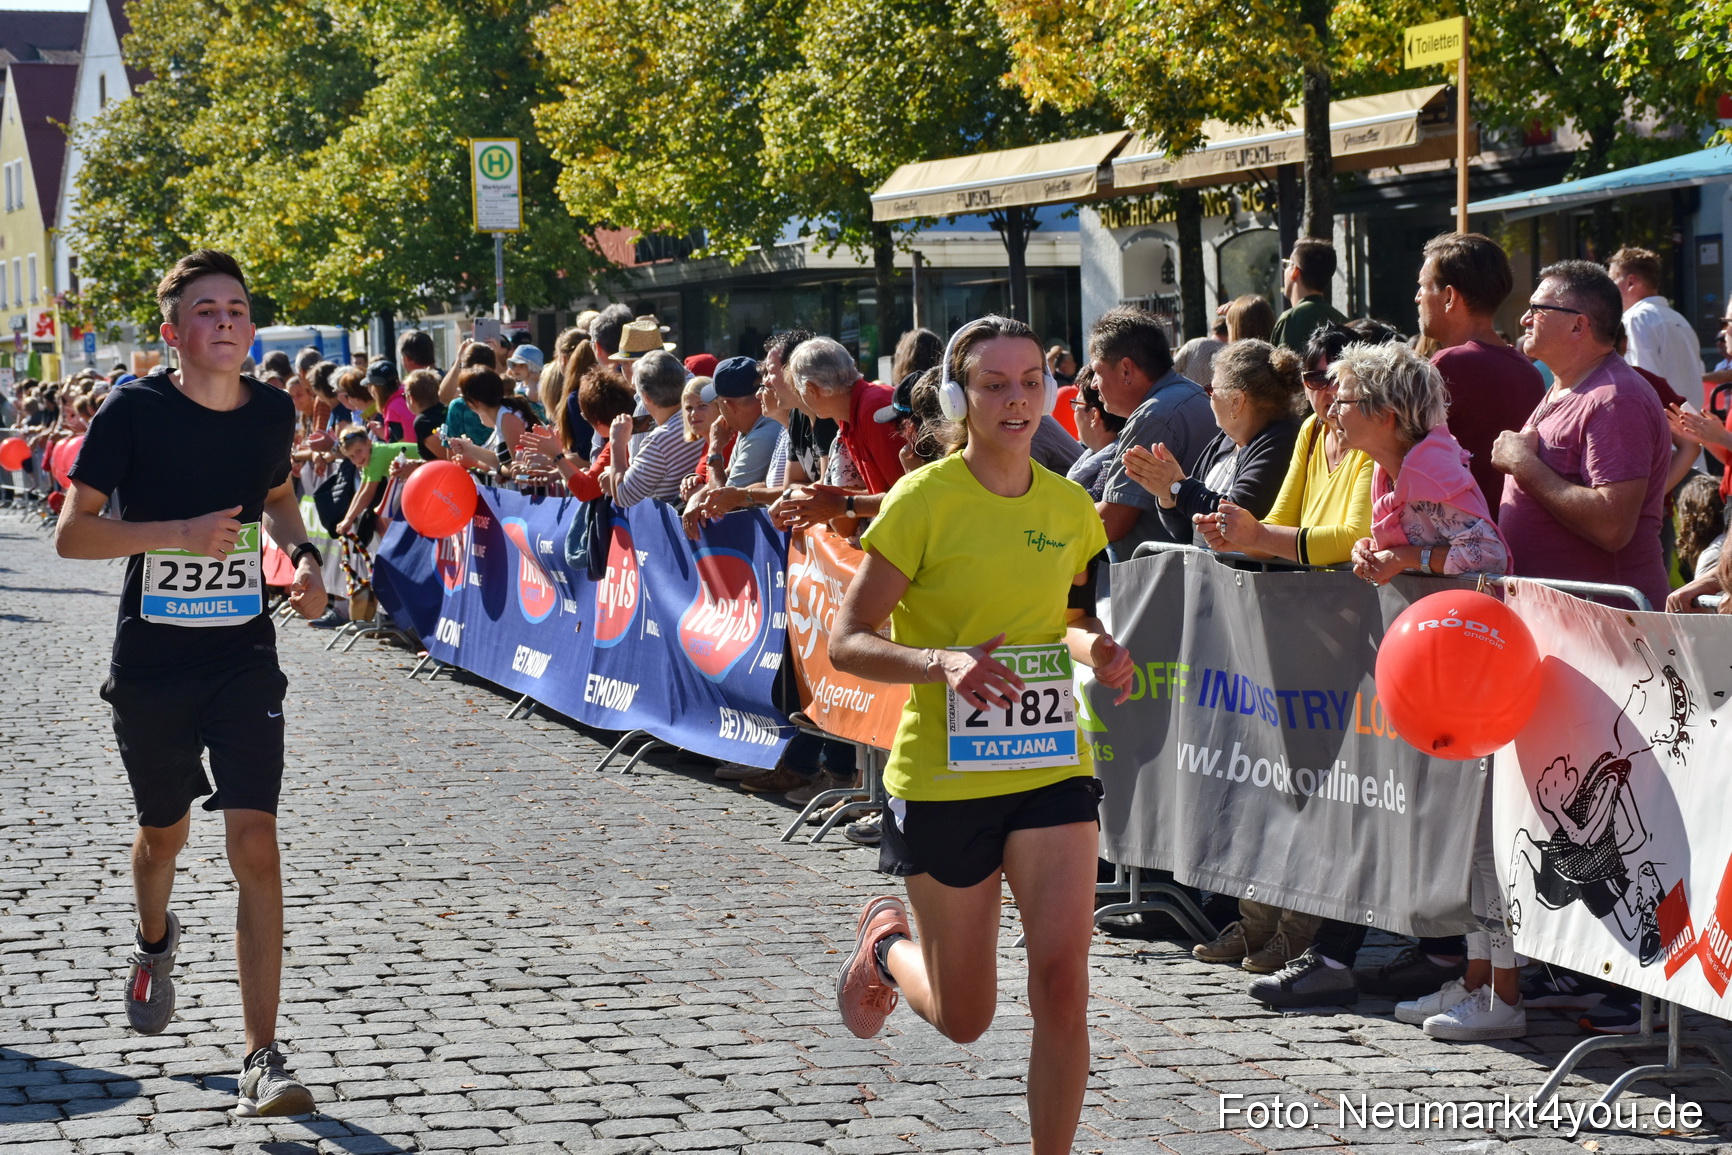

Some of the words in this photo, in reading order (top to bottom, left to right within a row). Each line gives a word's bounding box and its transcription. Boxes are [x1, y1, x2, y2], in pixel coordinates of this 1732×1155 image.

[1416, 34, 1459, 55] Toiletten
[1024, 530, 1066, 552] Tatjana
[158, 559, 247, 592] 2325
[165, 600, 238, 615] SAMUEL
[684, 580, 758, 651] hervis
[1417, 608, 1506, 644] RÖDL
[1463, 630, 1504, 650] energie
[814, 676, 875, 714] Agentur
[965, 687, 1063, 728] 2182
[1197, 668, 1349, 732] INDUSTRY
[971, 737, 1058, 757] TATJANA
